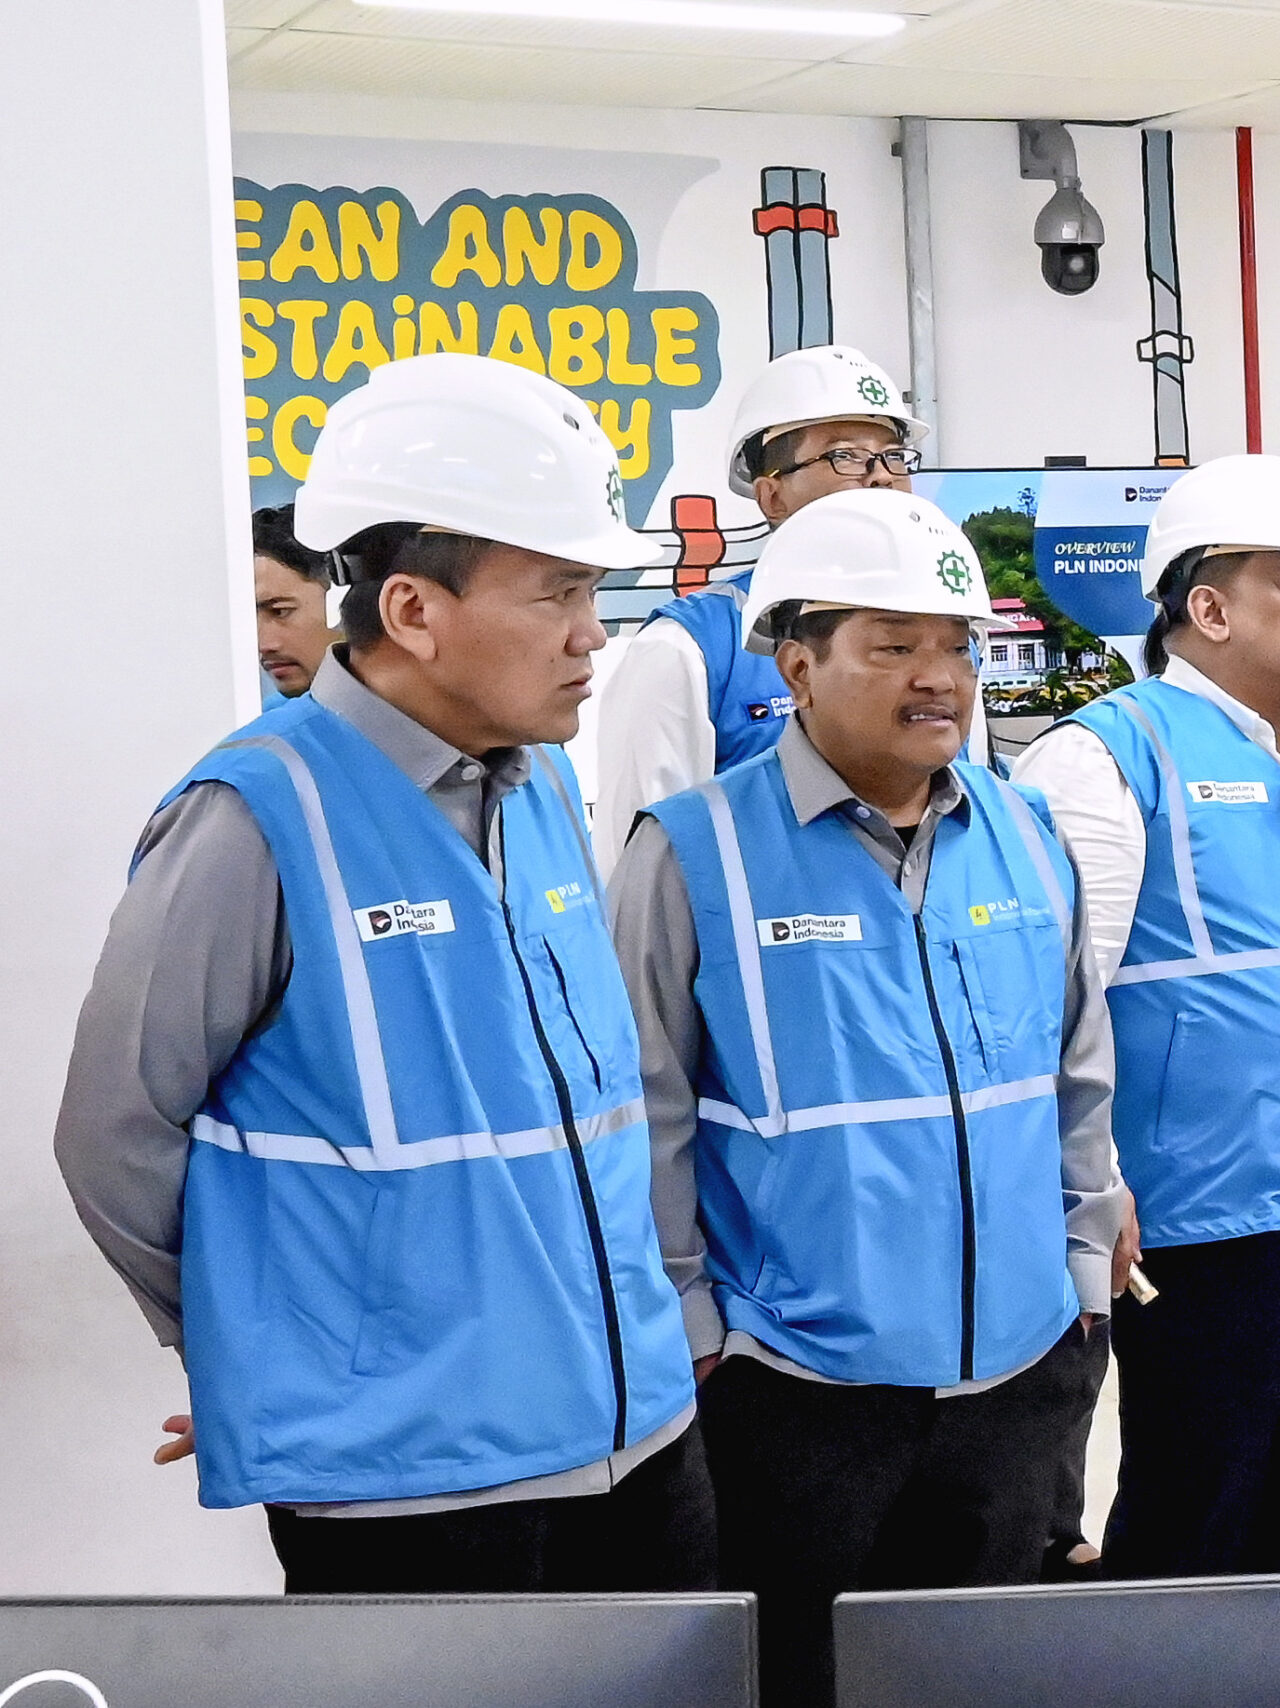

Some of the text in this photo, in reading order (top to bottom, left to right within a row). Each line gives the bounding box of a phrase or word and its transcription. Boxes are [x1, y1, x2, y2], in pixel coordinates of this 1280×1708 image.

[431, 204, 623, 292] AND
[1054, 540, 1137, 557] OVERVIEW
[1054, 559, 1143, 575] PLN INDON
[987, 897, 1020, 914] PLN
